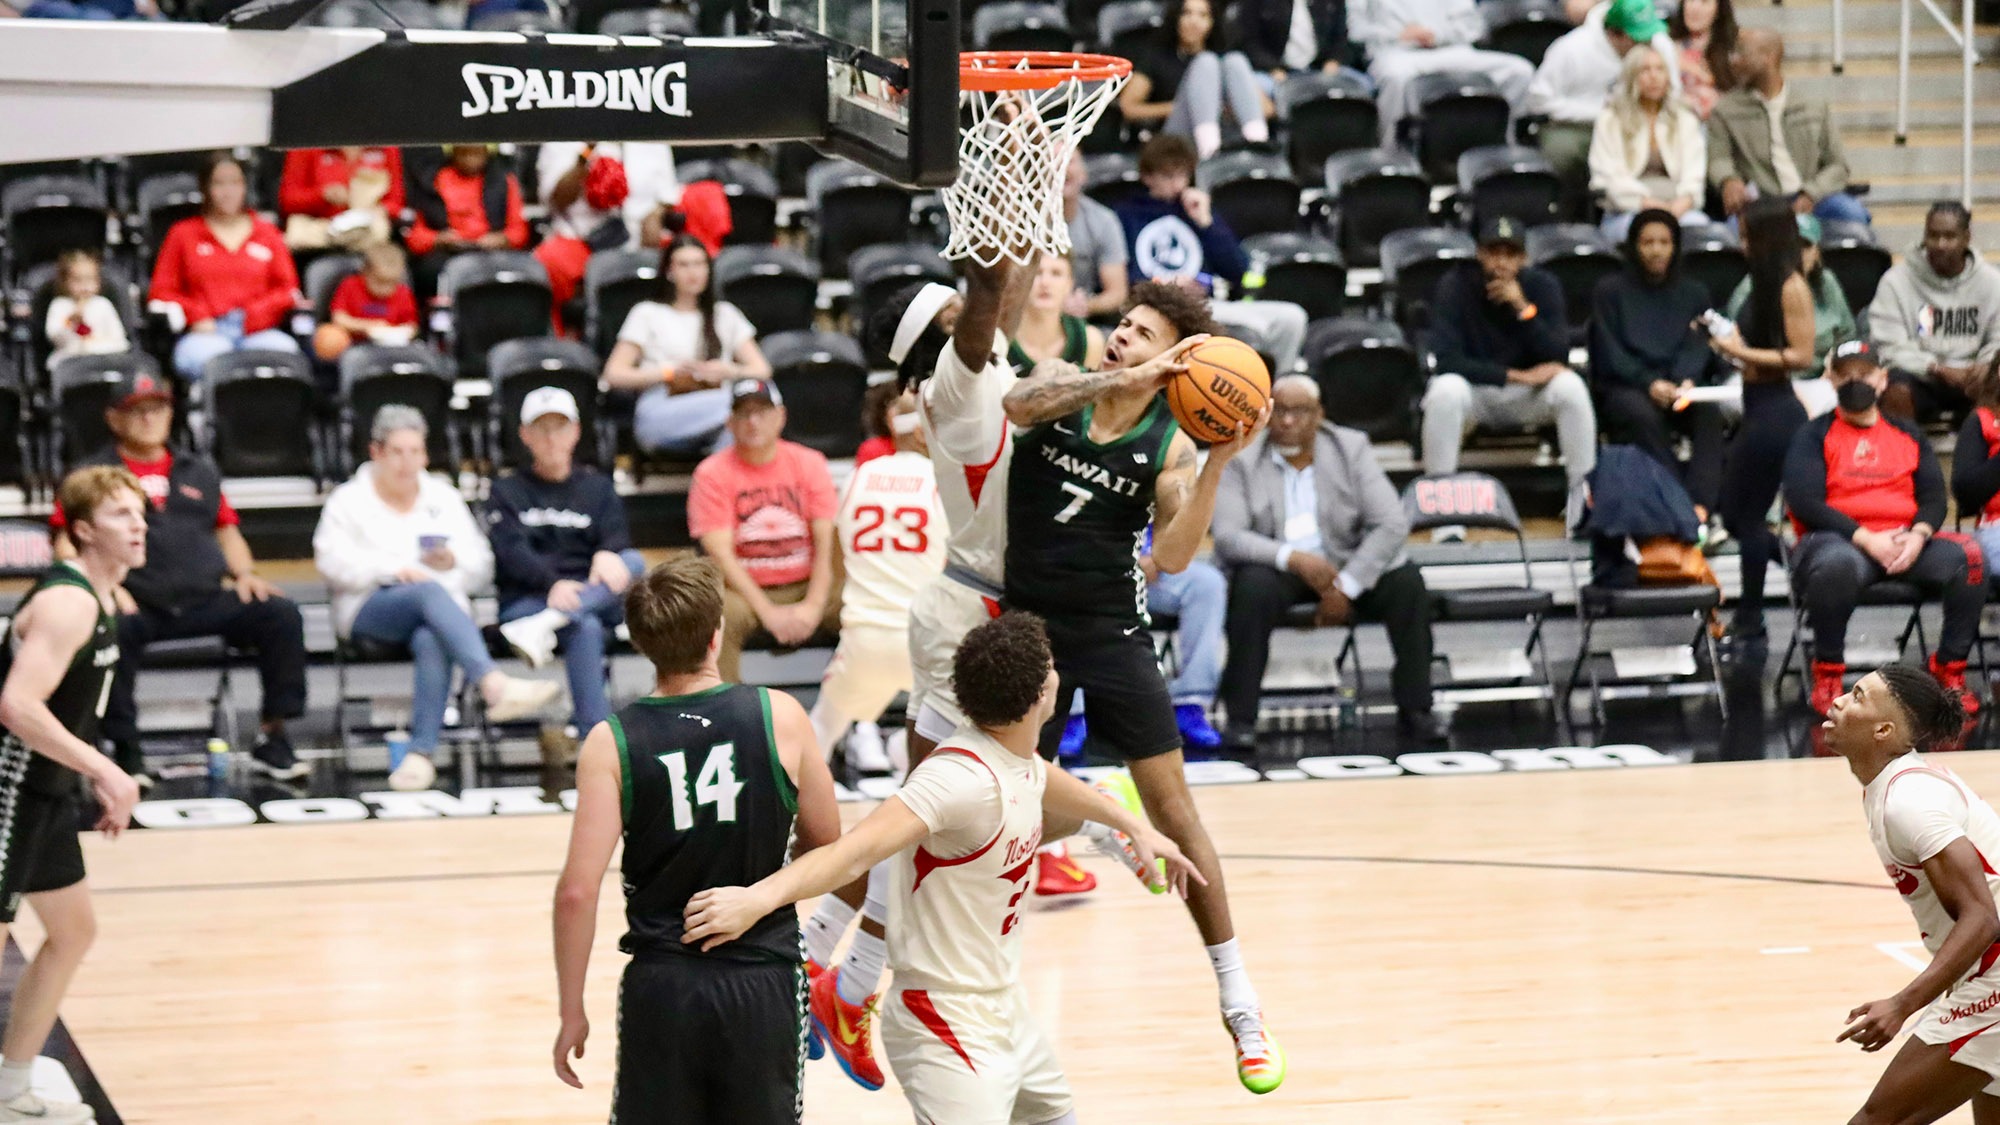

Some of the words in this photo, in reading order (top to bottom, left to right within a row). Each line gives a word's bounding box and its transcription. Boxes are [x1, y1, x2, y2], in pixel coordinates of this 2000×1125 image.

[461, 61, 688, 118] SPALDING
[1932, 306, 1979, 336] PARIS
[1210, 374, 1260, 421] Wilson
[1053, 481, 1094, 524] 7
[1415, 479, 1497, 514] CSUN
[853, 505, 928, 553] 23
[657, 742, 746, 831] 14
[1939, 990, 2000, 1025] Matad
